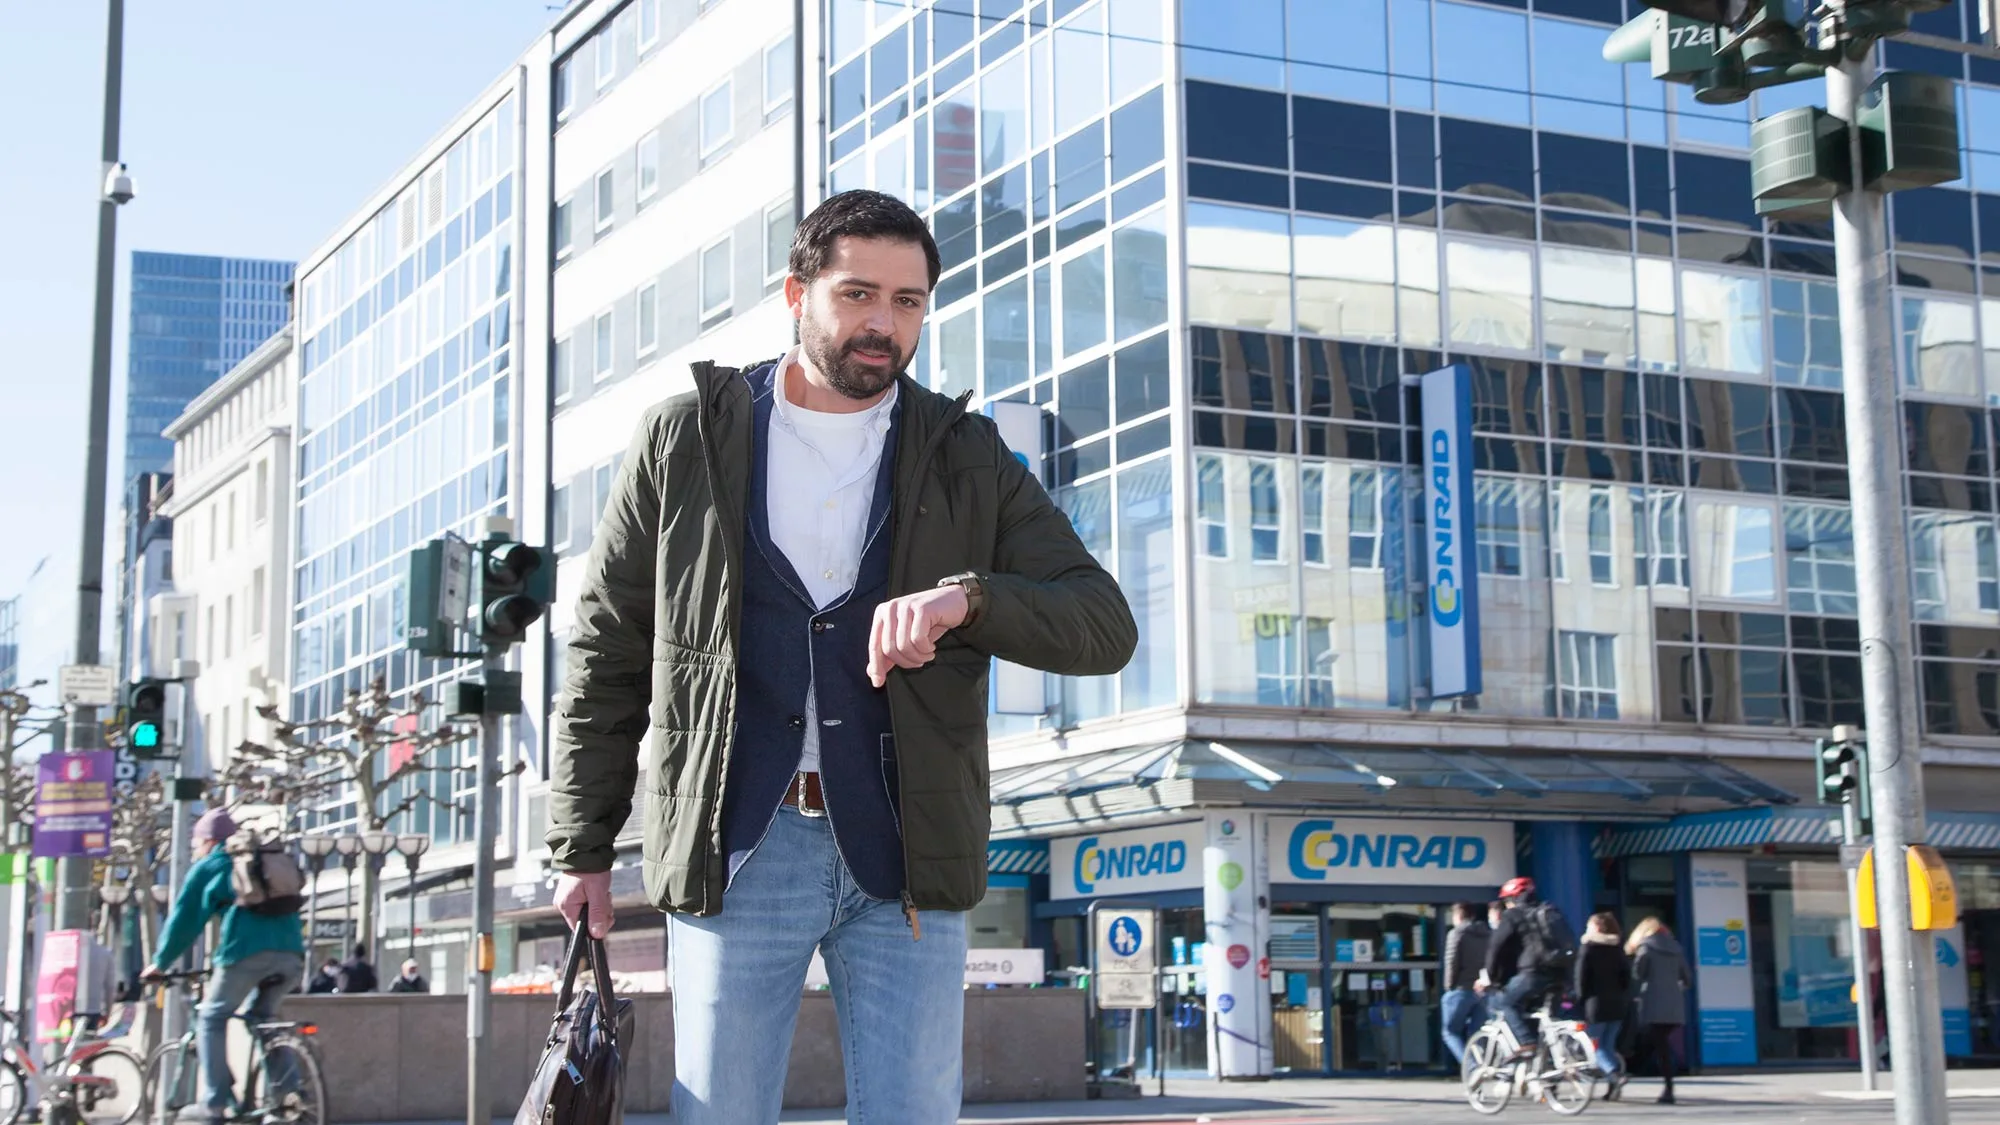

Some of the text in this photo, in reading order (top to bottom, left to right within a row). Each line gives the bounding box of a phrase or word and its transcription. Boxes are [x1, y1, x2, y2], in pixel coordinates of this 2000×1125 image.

[1669, 25, 1715, 49] 72a
[1431, 429, 1462, 628] CONRAD
[1074, 836, 1187, 894] CONRAD
[1288, 819, 1487, 881] CONRAD
